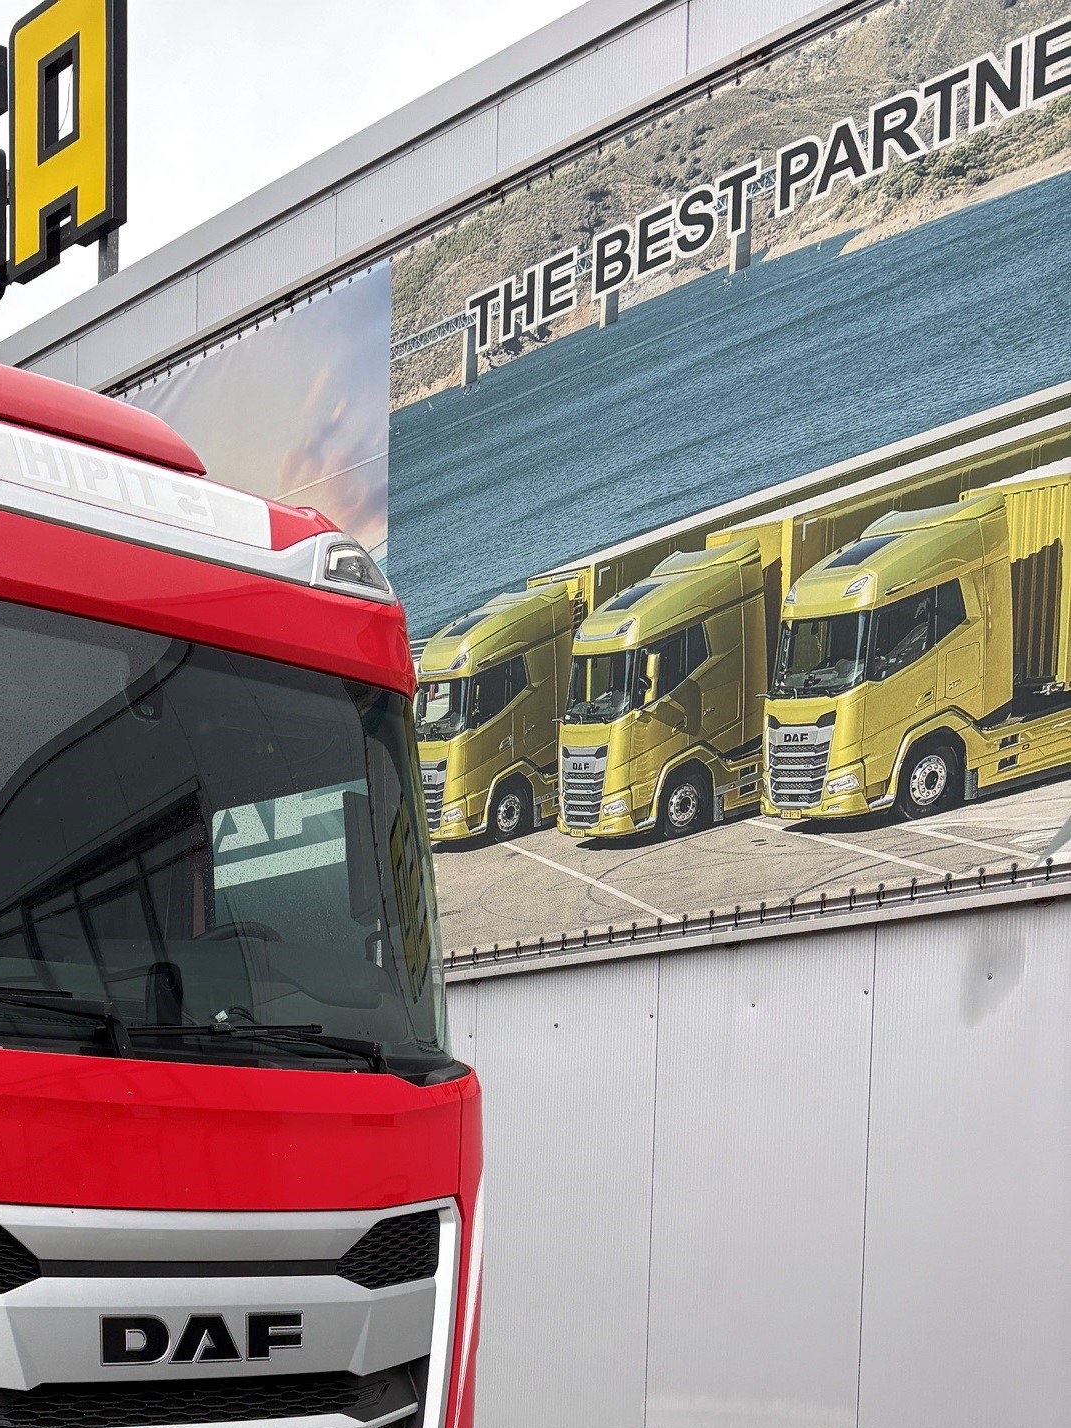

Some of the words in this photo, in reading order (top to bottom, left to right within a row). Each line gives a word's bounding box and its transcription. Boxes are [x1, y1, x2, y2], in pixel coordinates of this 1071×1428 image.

[469, 254, 574, 347] THE
[595, 165, 757, 295] BEST
[783, 733, 809, 742] DAF
[572, 762, 590, 770] DAF
[99, 1310, 304, 1366] DAF
